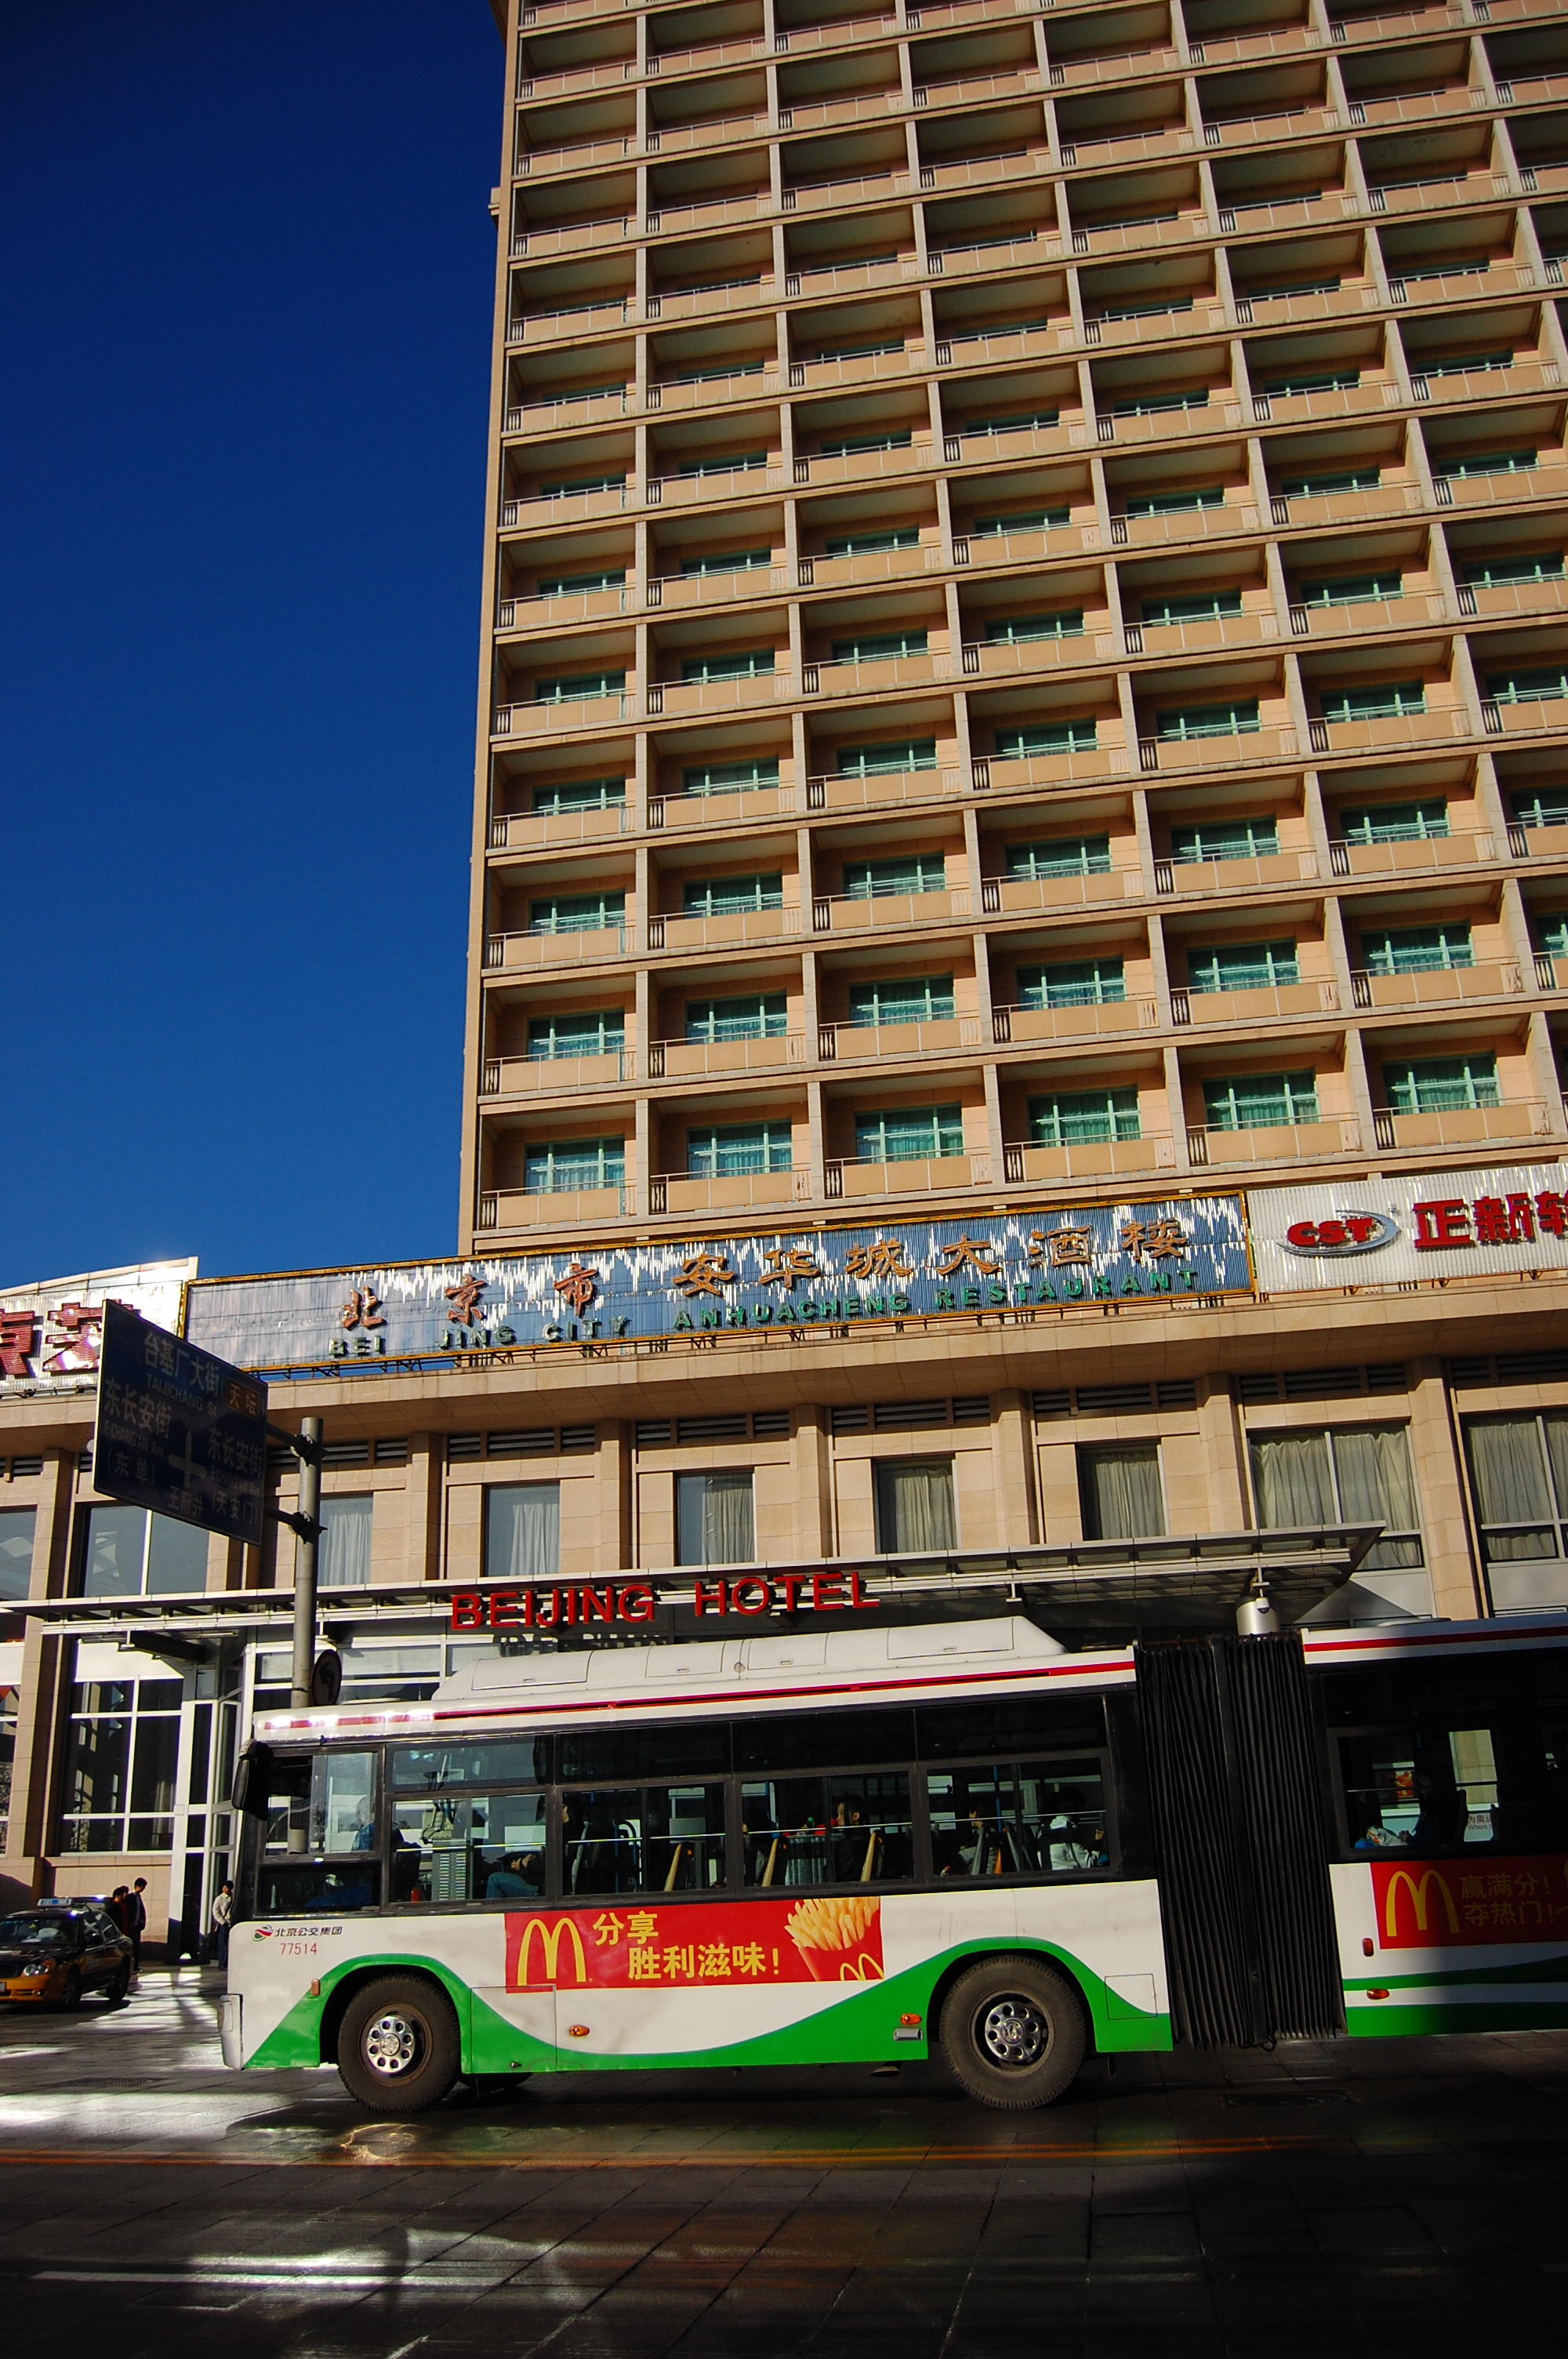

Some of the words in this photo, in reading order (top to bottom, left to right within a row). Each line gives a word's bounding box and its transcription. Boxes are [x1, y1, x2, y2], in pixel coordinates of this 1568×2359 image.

[1287, 1217, 1373, 1248] CST
[342, 1263, 599, 1331] 北京市
[673, 1216, 1189, 1298] 安华城大酒楼
[674, 1290, 909, 1331] ANHUACHENG
[936, 1267, 1197, 1310] RESTAURANT
[328, 1334, 386, 1358] BEI
[542, 1314, 630, 1343] CITY
[144, 1332, 220, 1397] 台基厂大街
[104, 1376, 172, 1440] 东长安街
[146, 1372, 203, 1411] TAIJICHANG
[207, 1401, 217, 1417] St
[208, 1426, 263, 1479] 东长安街
[168, 1485, 204, 1518] 王府井
[451, 1584, 655, 1630] BEIJING
[695, 1571, 880, 1617] HOTEL
[274, 1926, 343, 1937] 北京公交集团
[280, 1943, 318, 1955] 77514
[592, 1910, 659, 1946] 分享
